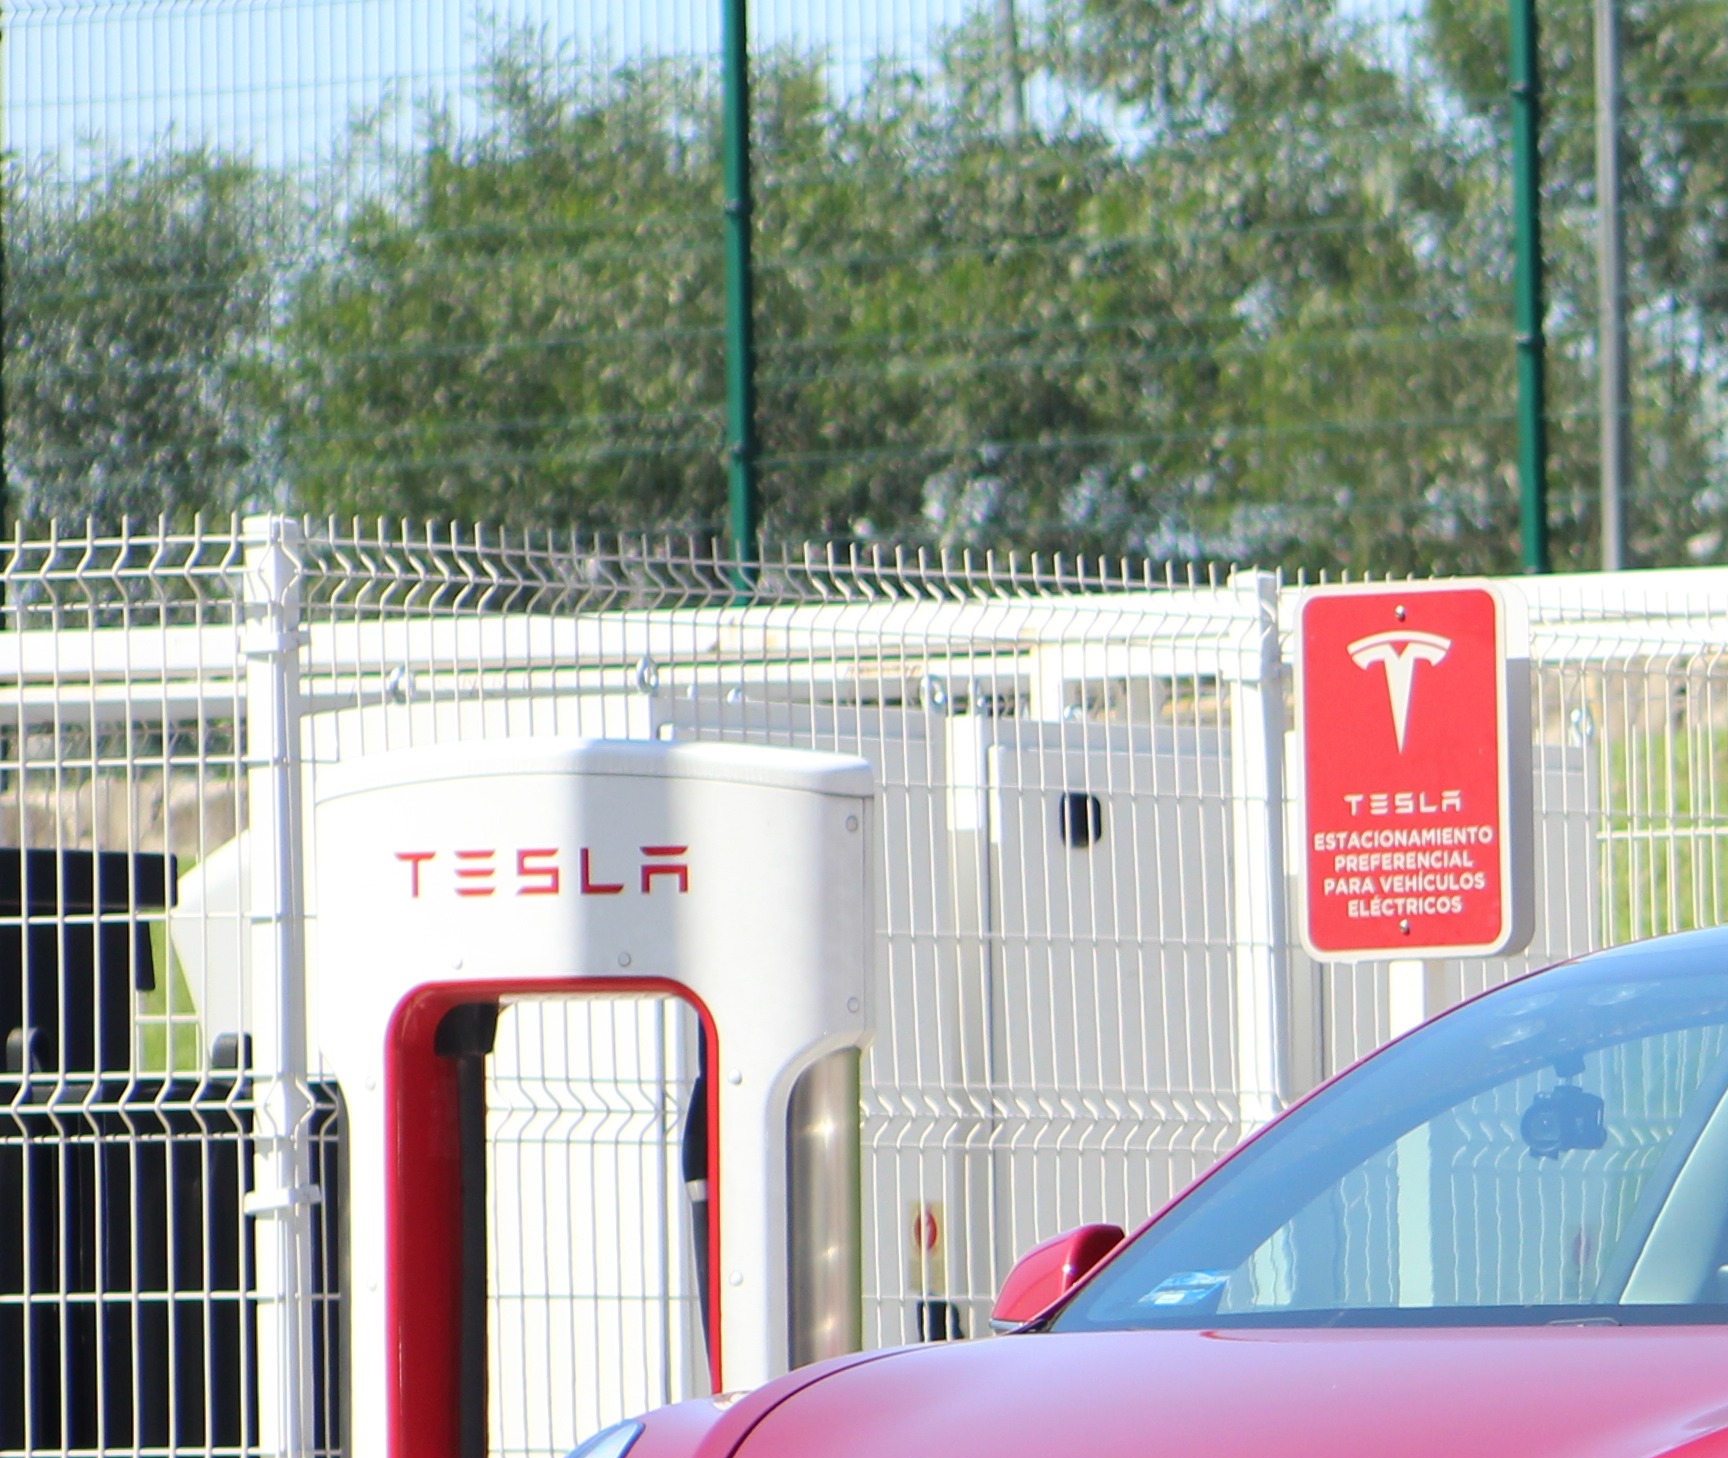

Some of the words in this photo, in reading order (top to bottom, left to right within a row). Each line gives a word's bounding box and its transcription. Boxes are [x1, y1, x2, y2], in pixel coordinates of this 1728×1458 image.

[1343, 790, 1462, 816] TESLA
[1314, 826, 1493, 850] ESTACIONAMIENTO
[395, 846, 689, 899] TESLA
[1334, 850, 1474, 873] PREFERENCIAL
[1324, 876, 1374, 895] PARA
[1379, 869, 1486, 894] VEHÍCULOS
[1347, 894, 1463, 918] ELÉCTRICOS
